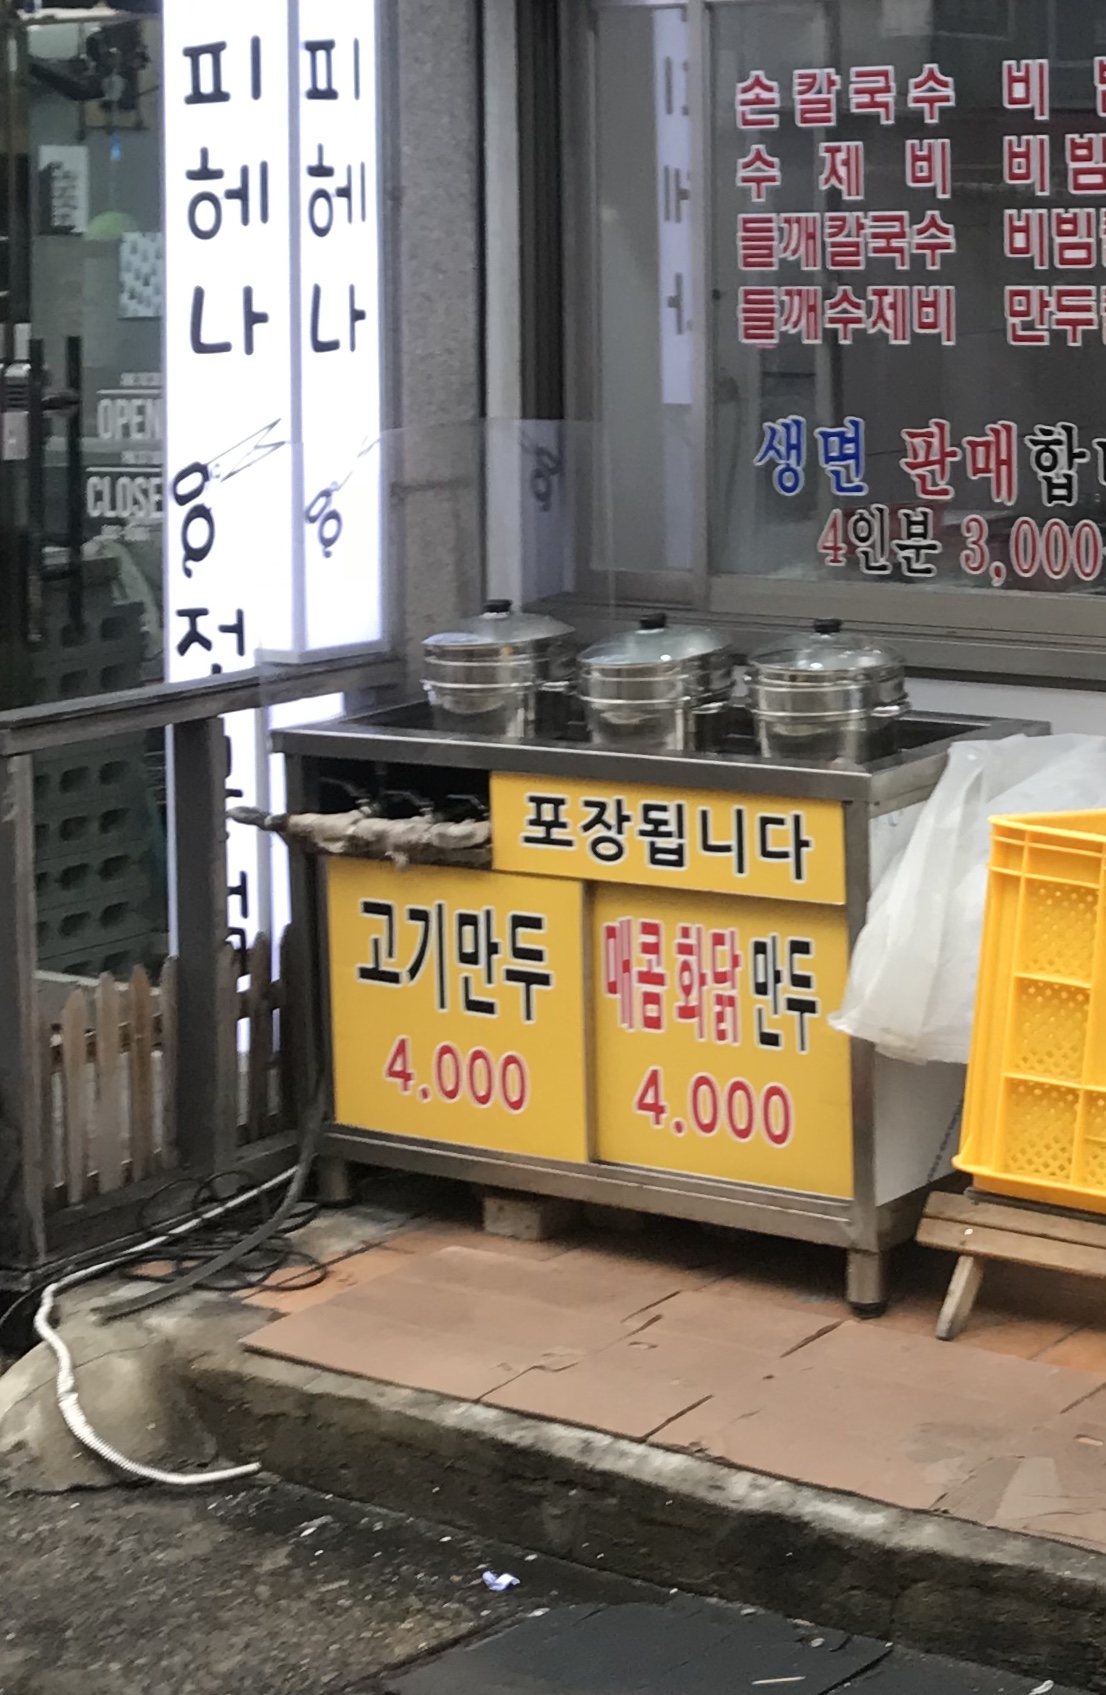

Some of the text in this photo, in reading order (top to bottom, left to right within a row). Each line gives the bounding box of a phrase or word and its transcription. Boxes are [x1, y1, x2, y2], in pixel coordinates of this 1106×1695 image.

[735, 63, 957, 129] 손칼국수
[737, 210, 957, 271] 들깨칼국수
[737, 285, 957, 347] 들깨수제비
[752, 413, 870, 498] 생면
[816, 503, 945, 578] 4인분
[520, 792, 815, 884] 포장됩니다
[356, 898, 555, 1024] 고기만두
[383, 1036, 531, 1113] 4.000
[633, 1063, 796, 1147] 4.000
